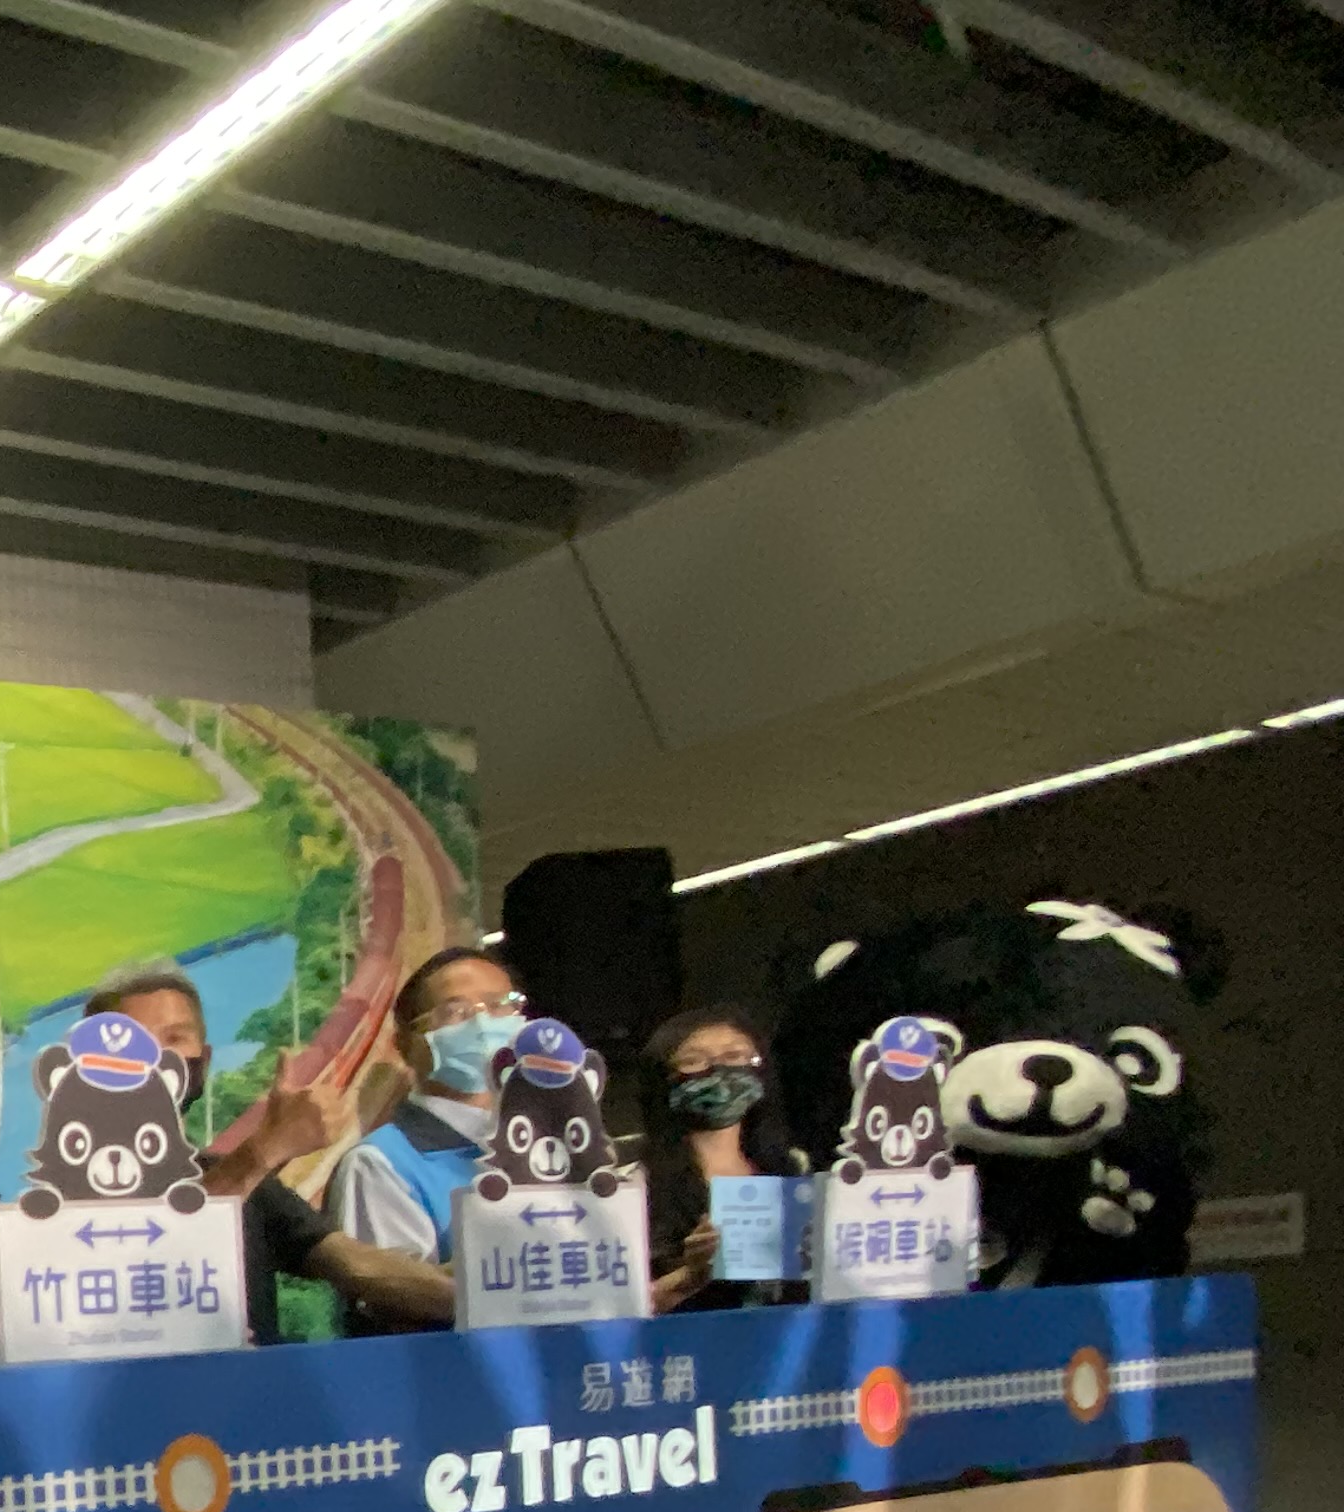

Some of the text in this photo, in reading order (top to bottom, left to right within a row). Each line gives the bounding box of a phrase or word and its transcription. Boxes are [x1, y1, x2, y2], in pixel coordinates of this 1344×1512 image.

[23, 1259, 220, 1324] 竹田車站
[480, 1236, 629, 1293] 山佳車站
[580, 1355, 696, 1412] 易遊網
